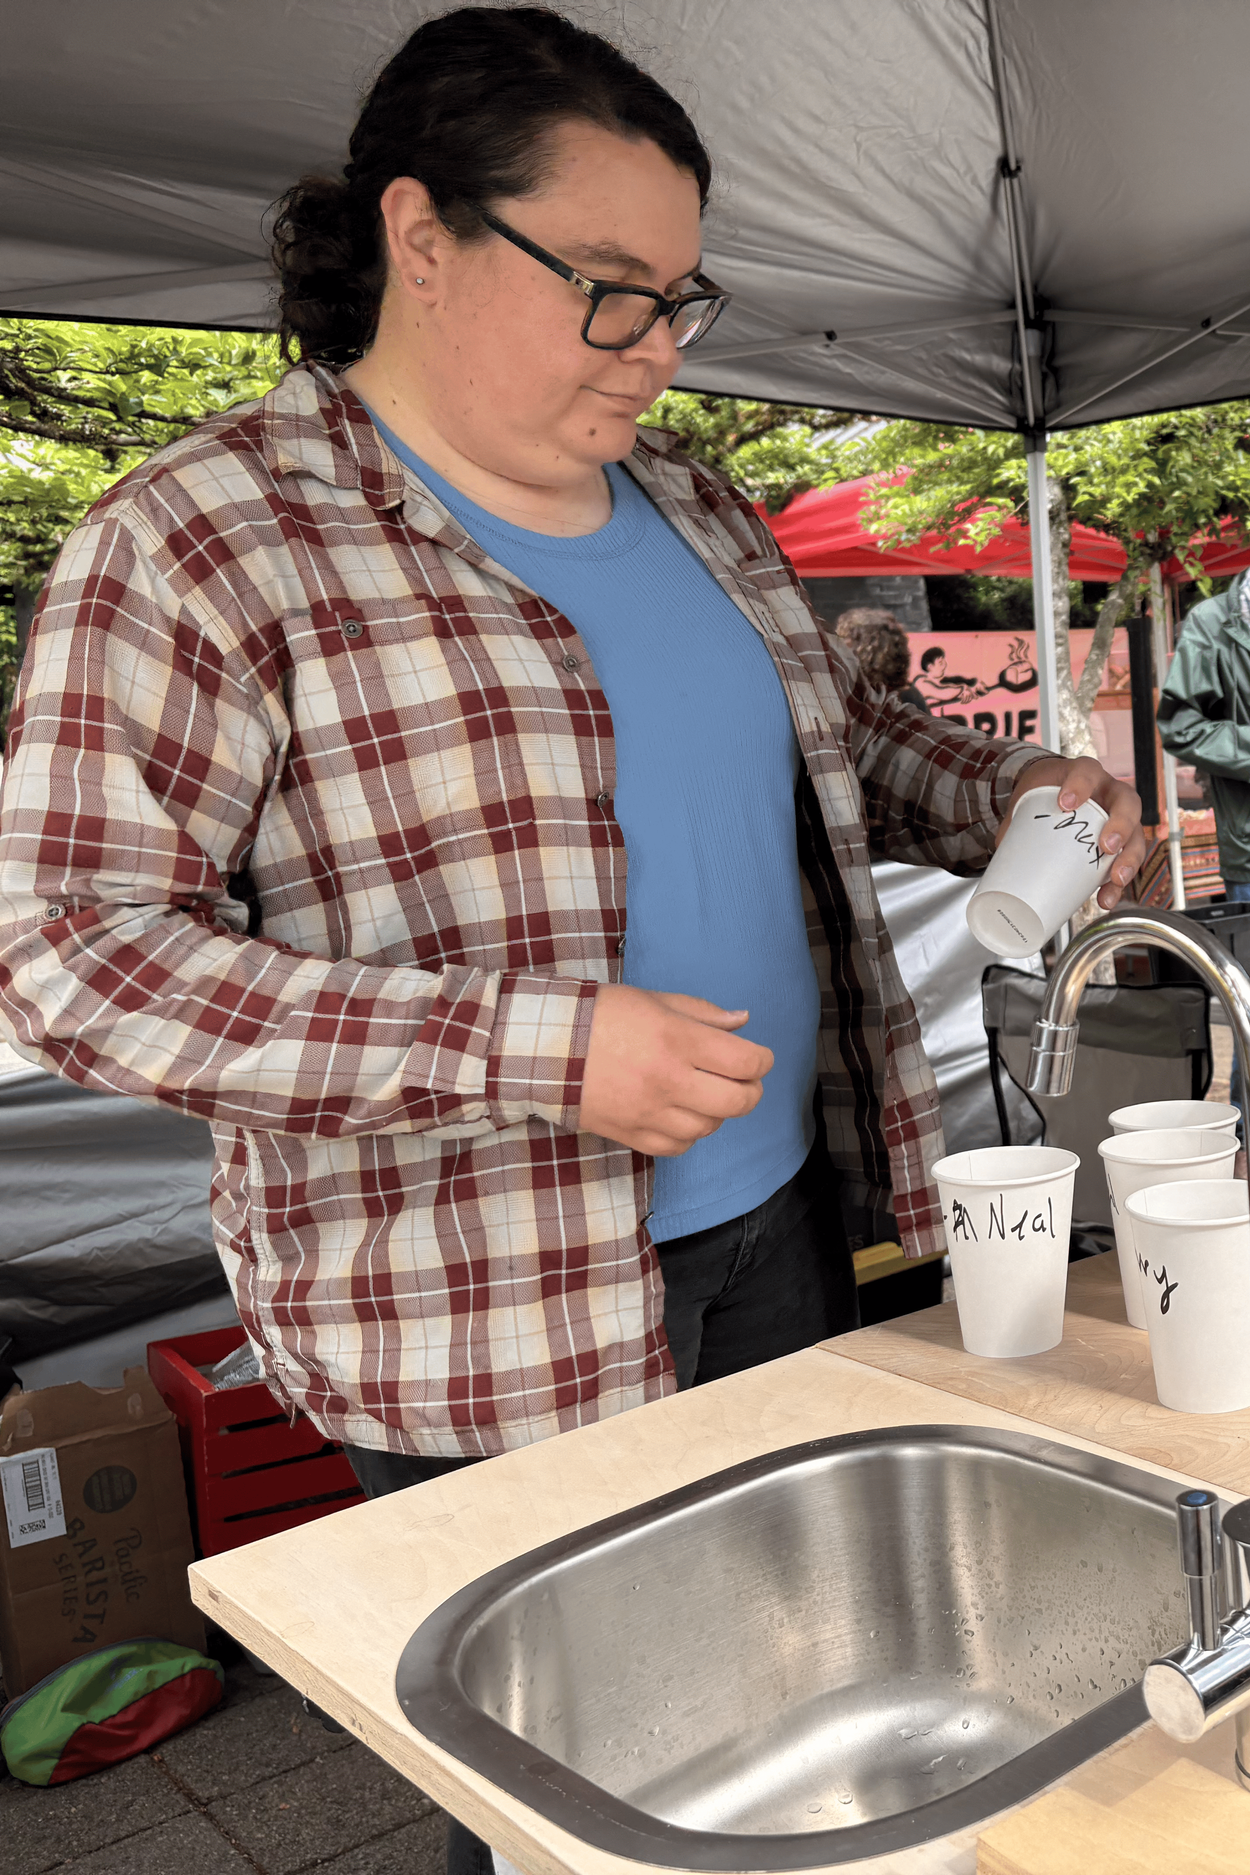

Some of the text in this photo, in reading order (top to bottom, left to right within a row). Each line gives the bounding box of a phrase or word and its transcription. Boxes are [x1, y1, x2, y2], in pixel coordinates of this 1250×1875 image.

[988, 1193, 1055, 1241] Neal
[53, 1552, 78, 1620] SERIES
[66, 1517, 108, 1645] BARISTA
[113, 1528, 148, 1604] Pacific
